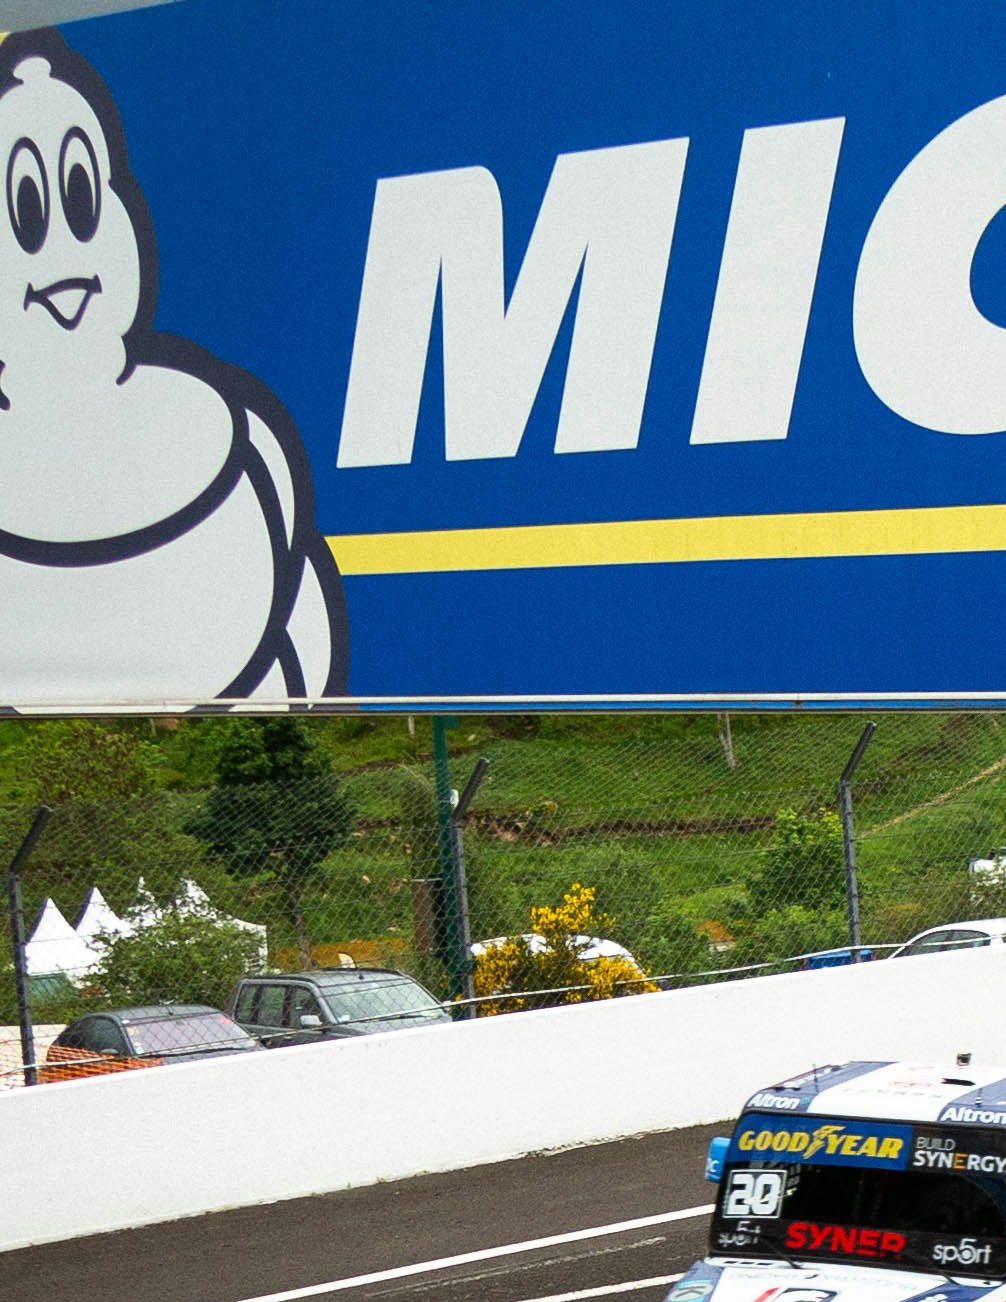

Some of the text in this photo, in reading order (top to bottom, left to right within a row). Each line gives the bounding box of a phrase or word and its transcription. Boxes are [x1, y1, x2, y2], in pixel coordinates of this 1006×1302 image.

[748, 1093, 800, 1110] Altron
[916, 1136, 956, 1151] BUILD
[727, 1173, 782, 1216] 20
